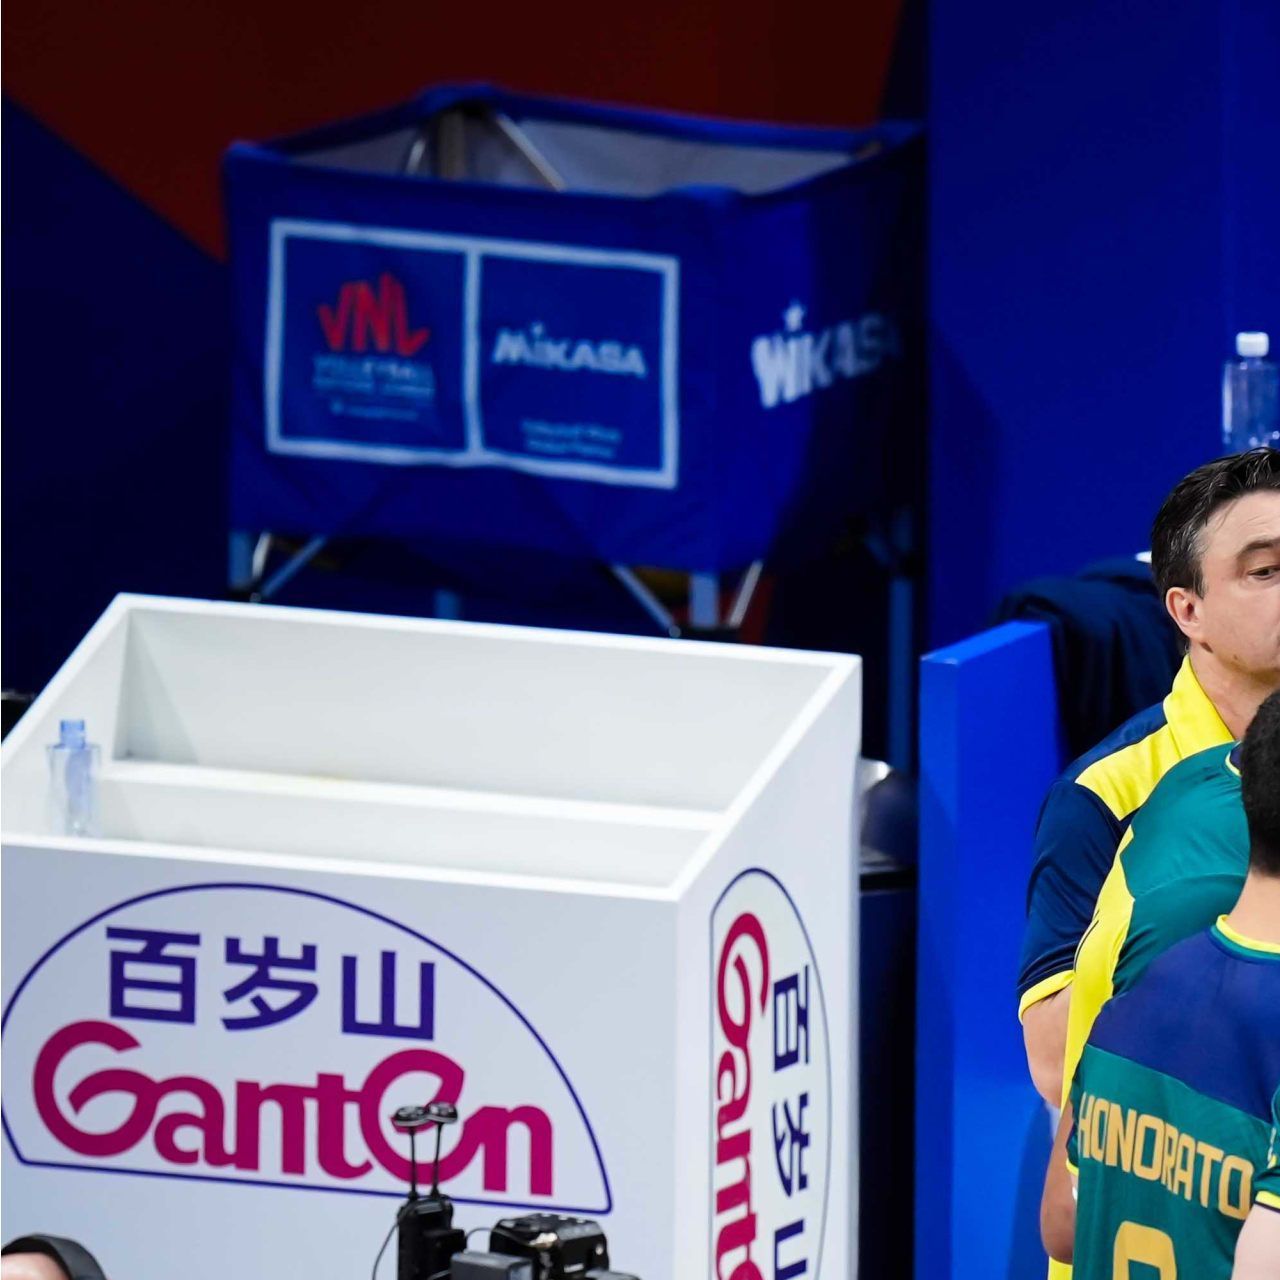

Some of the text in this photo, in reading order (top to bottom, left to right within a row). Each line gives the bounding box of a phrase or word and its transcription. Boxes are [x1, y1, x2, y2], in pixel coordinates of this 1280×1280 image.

[105, 926, 435, 1041] 百岁山
[1077, 1091, 1255, 1221] HONORATO
